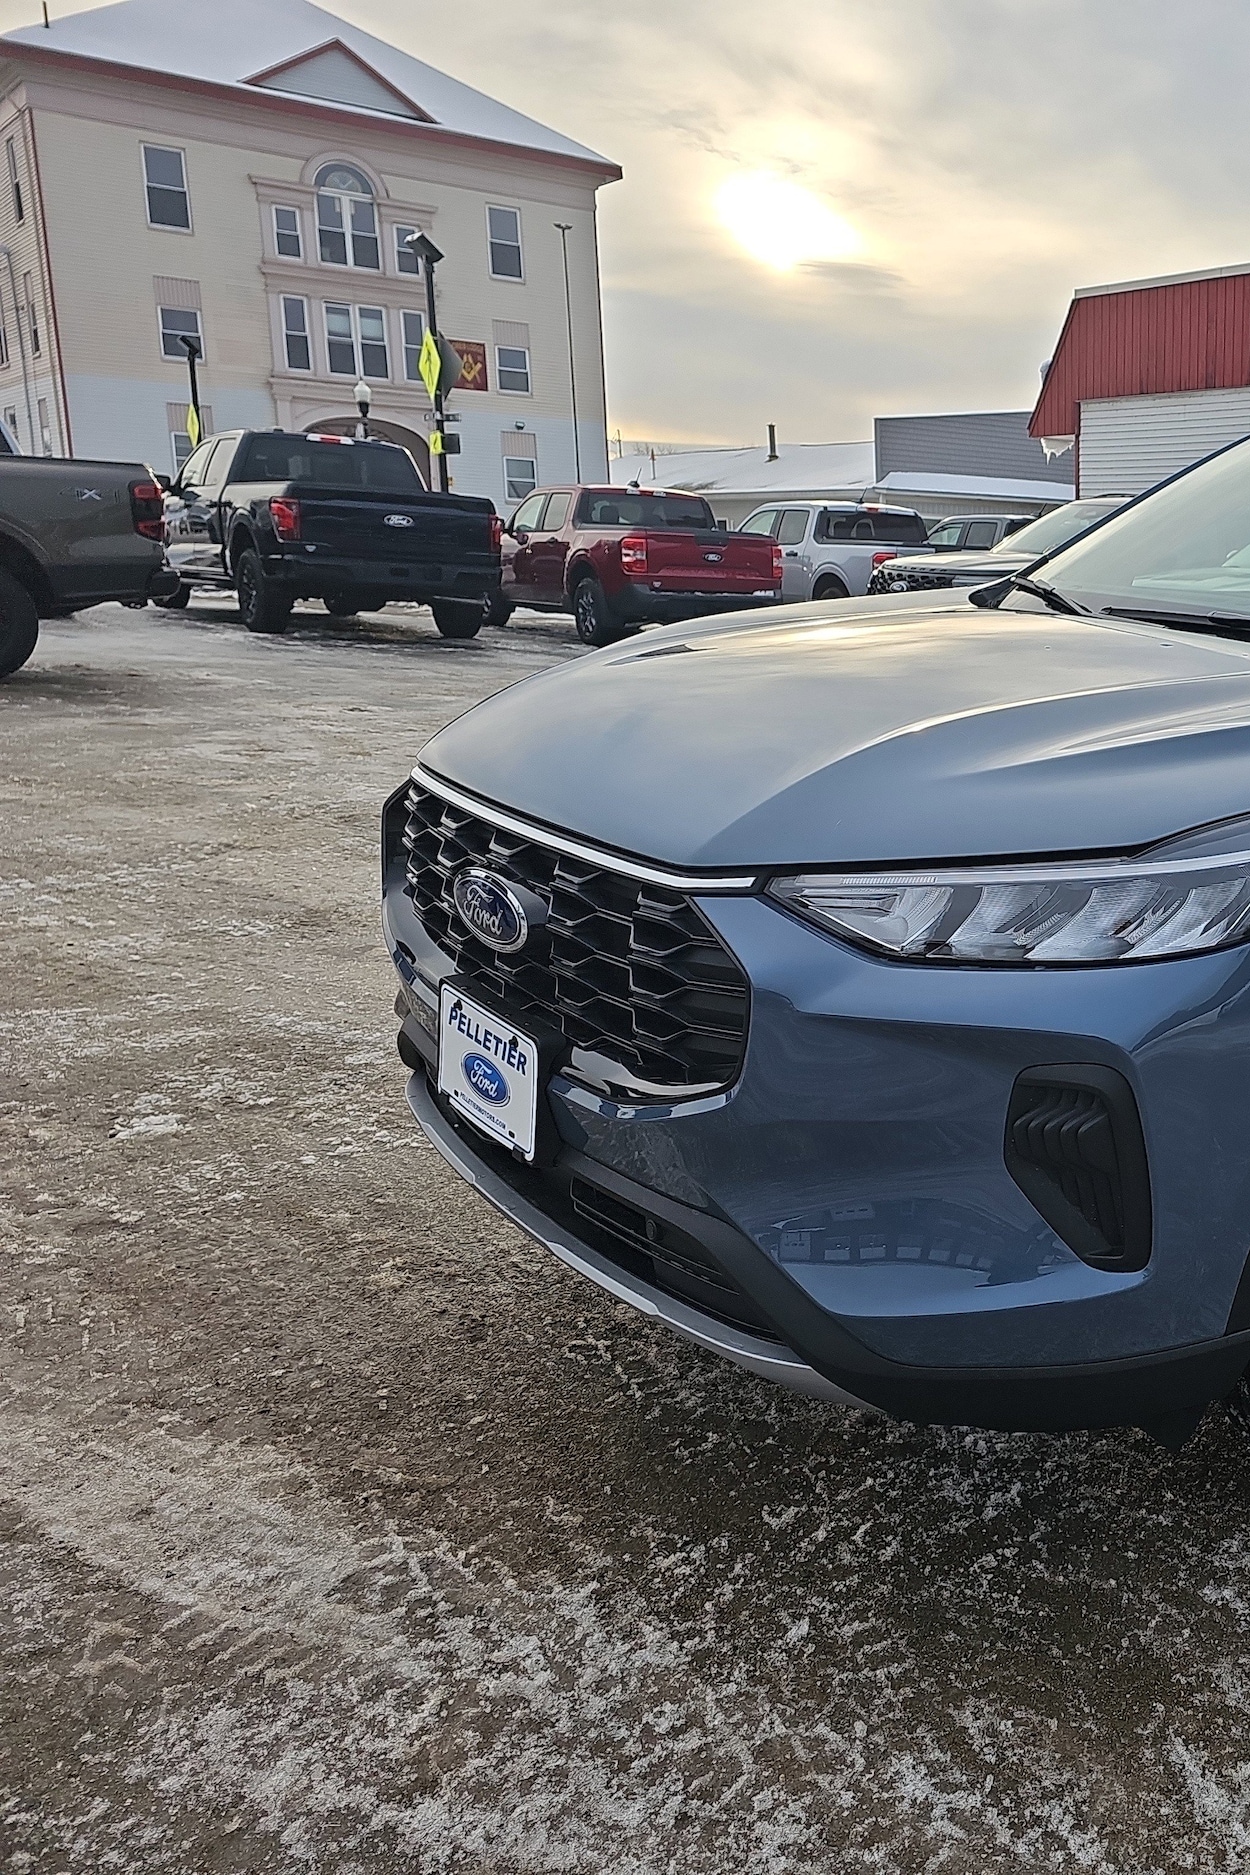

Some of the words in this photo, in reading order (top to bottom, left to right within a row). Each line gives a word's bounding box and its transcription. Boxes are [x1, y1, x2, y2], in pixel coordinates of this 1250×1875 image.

[464, 885, 508, 936] Ford
[448, 1006, 527, 1076] PELLETIER
[470, 1060, 499, 1098] Ford
